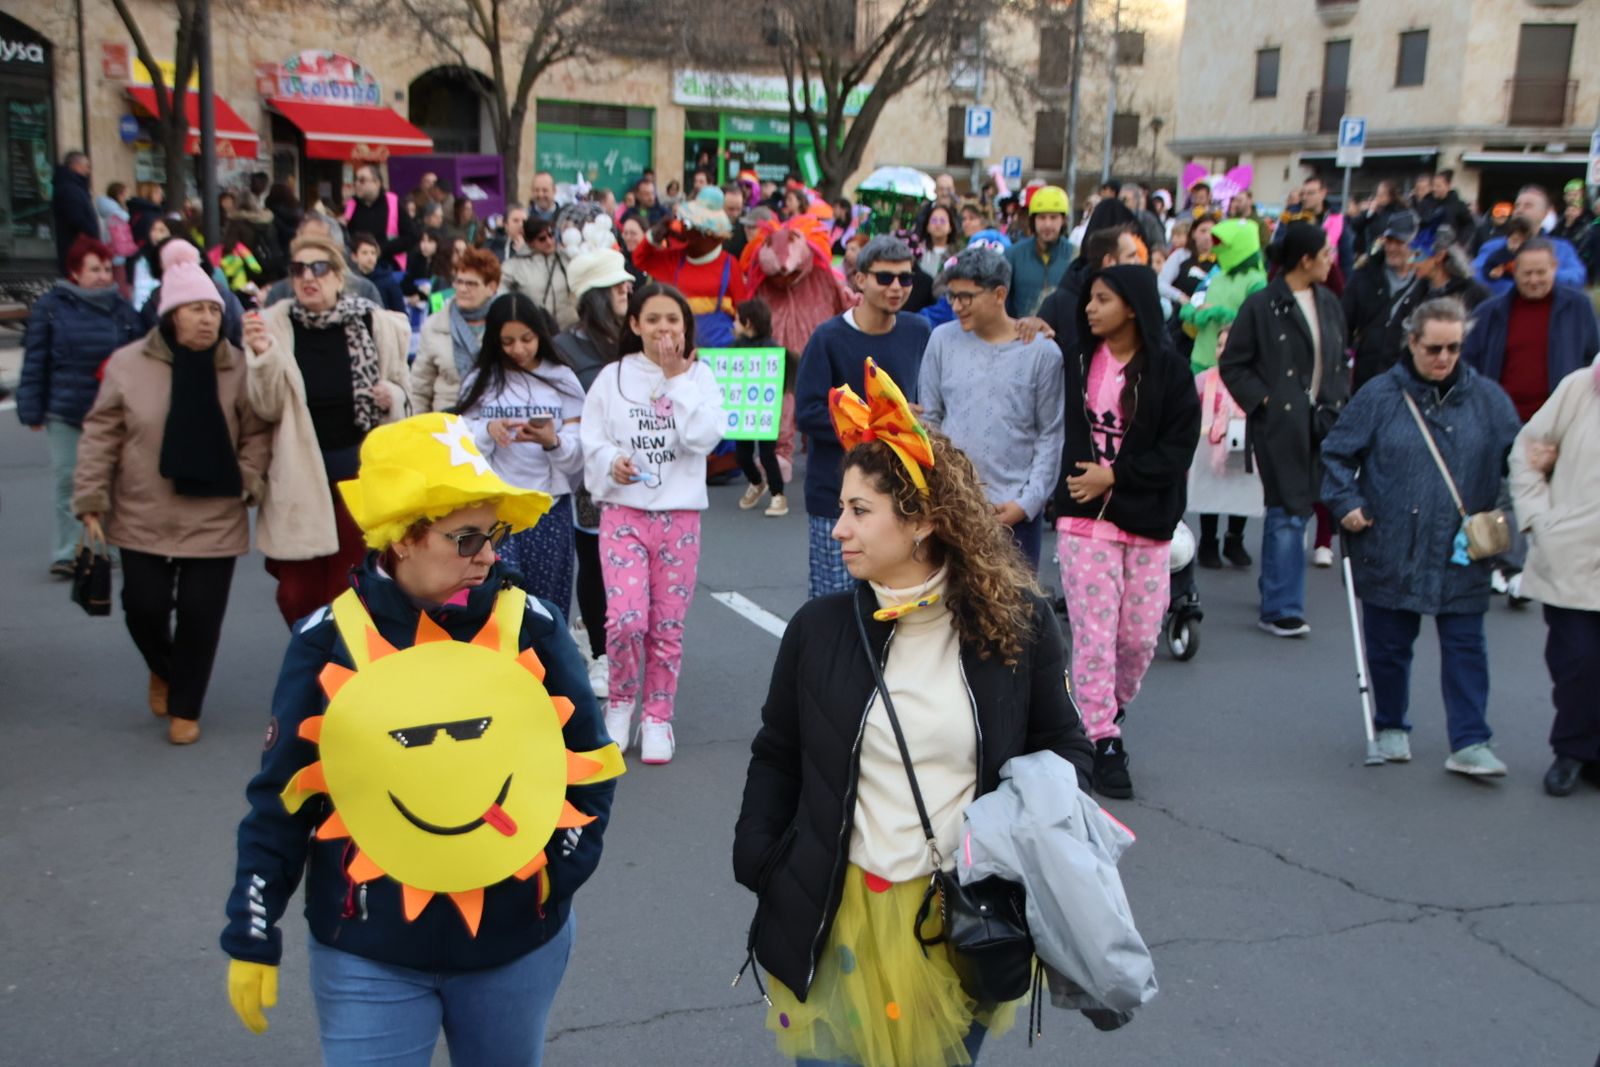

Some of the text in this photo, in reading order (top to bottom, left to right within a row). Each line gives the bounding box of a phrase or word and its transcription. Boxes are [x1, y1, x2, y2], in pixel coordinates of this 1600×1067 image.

[970, 110, 988, 135] P
[1343, 121, 1361, 145] P
[1005, 159, 1018, 176] P
[717, 360, 728, 372] 14
[732, 361, 745, 373] 45
[767, 360, 778, 373] 15
[480, 405, 562, 419] EORGETOWN
[629, 408, 654, 419] STILL
[745, 414, 756, 427] 13
[631, 435, 666, 450] NEW
[646, 449, 677, 465] YORK
